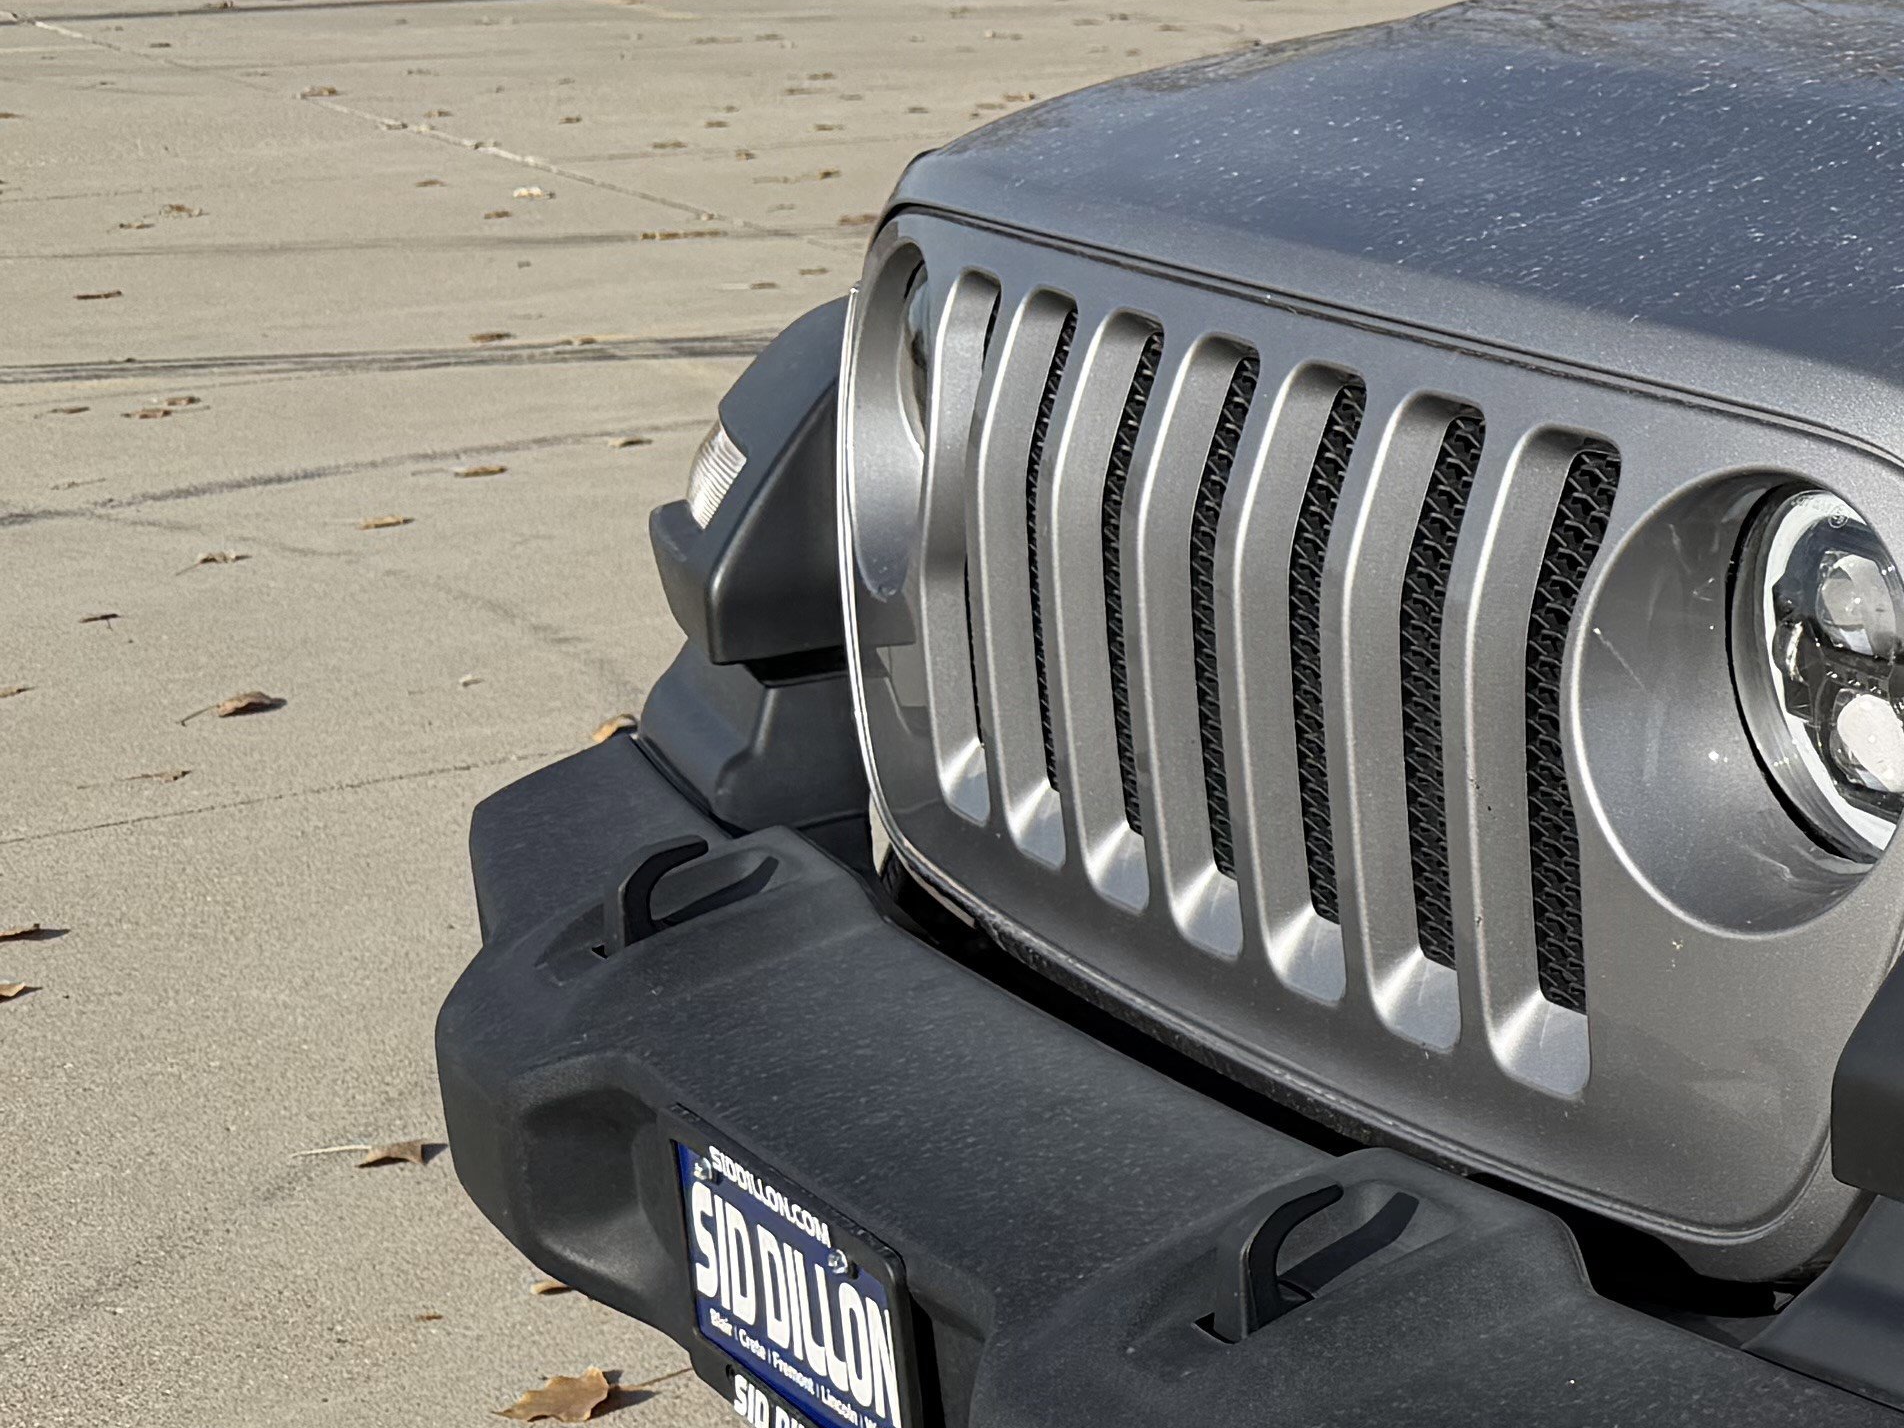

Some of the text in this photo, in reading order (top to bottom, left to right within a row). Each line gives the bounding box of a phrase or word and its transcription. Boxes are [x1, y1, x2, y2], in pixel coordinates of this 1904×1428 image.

[709, 1145, 832, 1248] SIDDILLON.COM
[692, 1181, 756, 1326] SID
[738, 1327, 767, 1361] Crete
[821, 1385, 859, 1428] Lincoln
